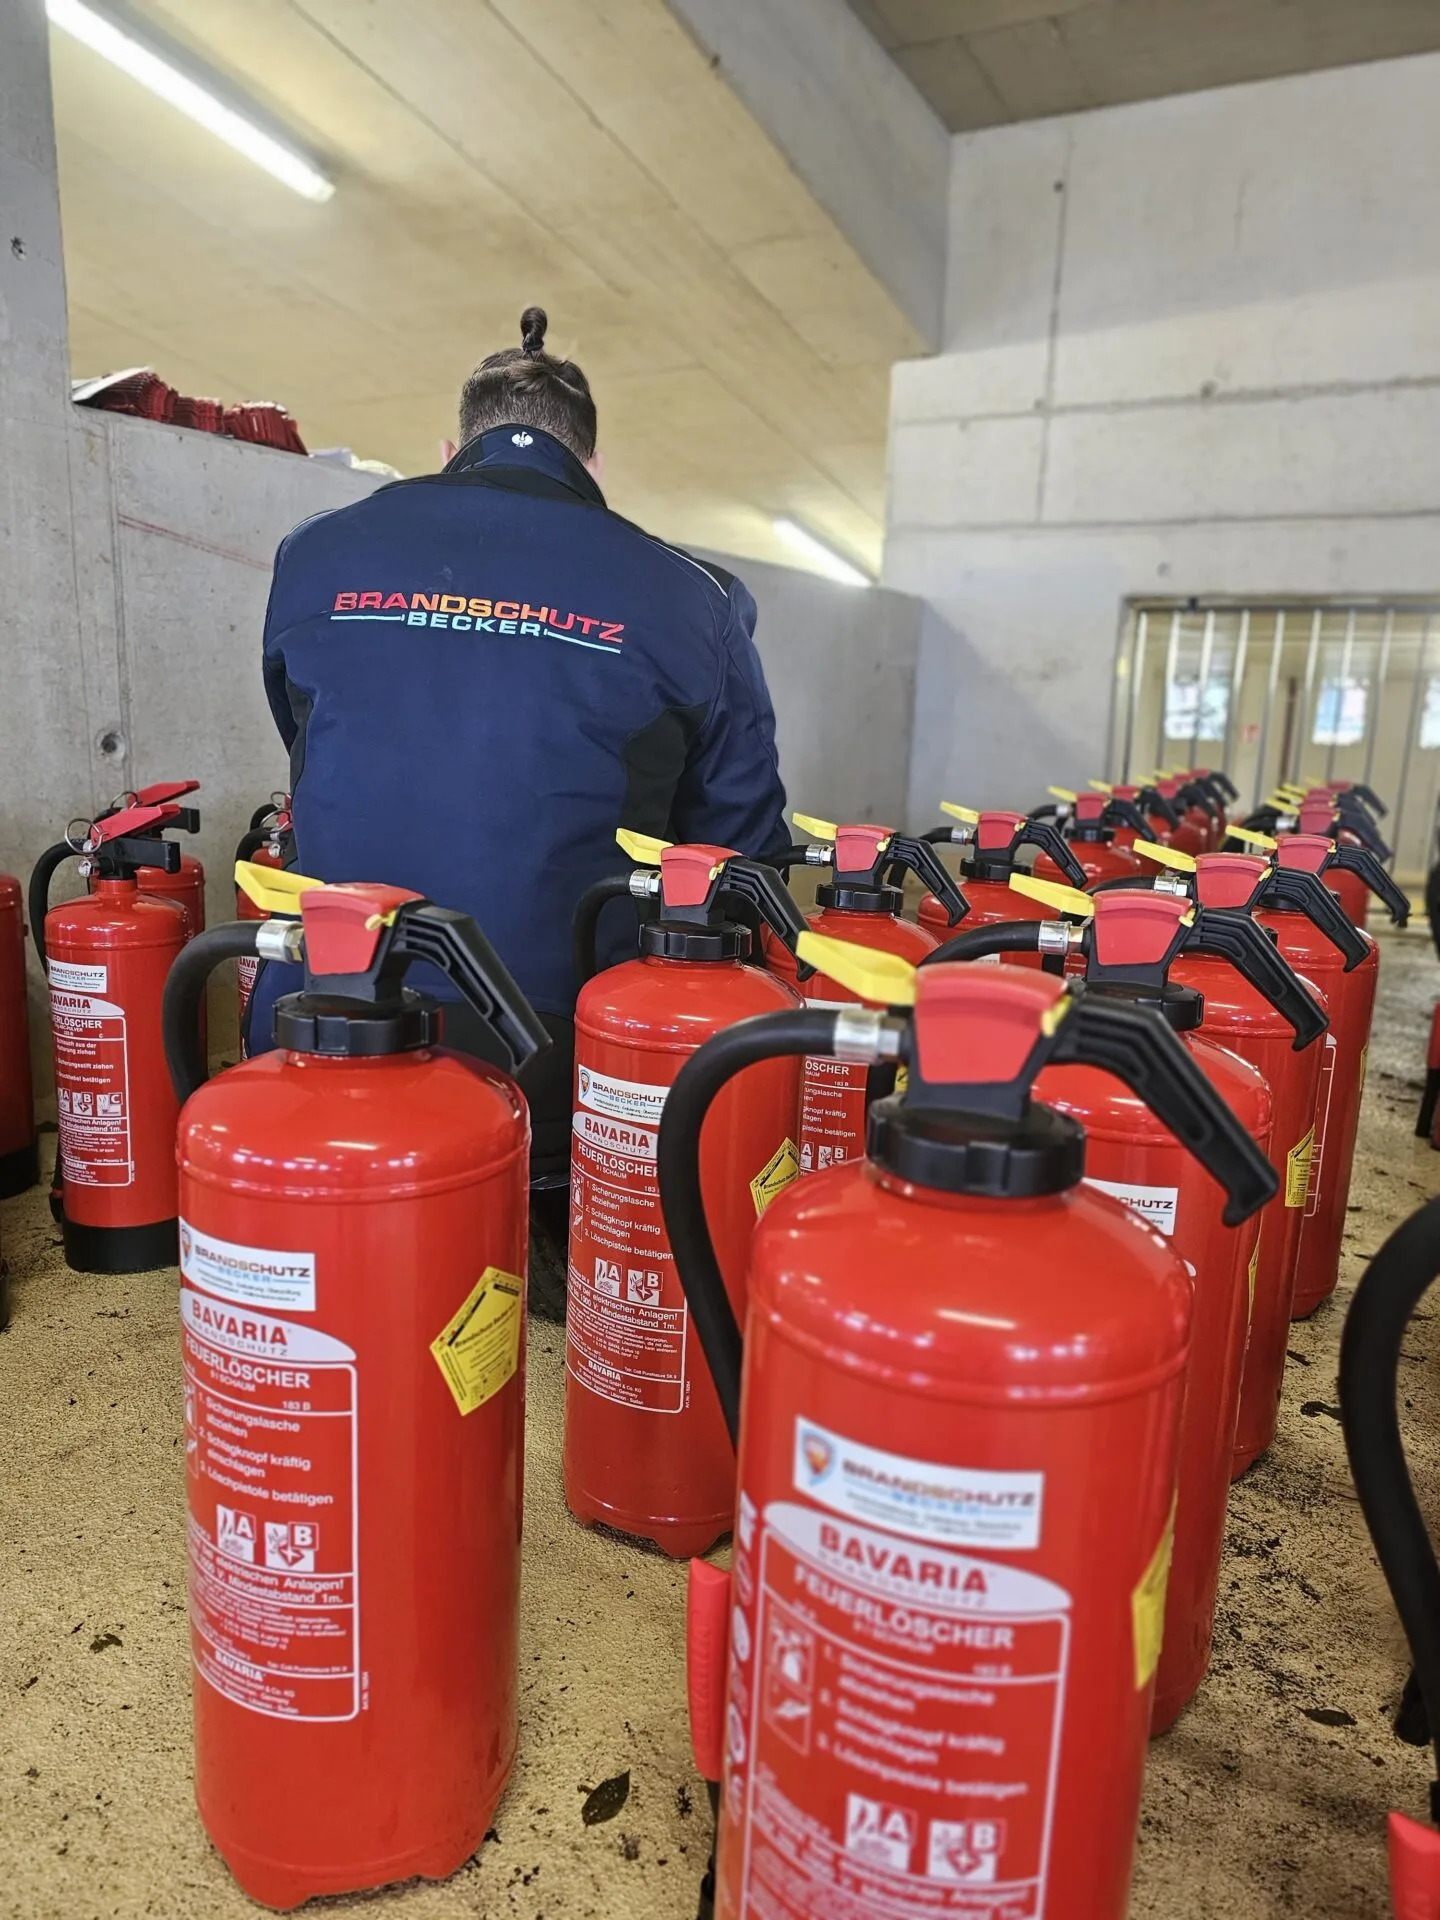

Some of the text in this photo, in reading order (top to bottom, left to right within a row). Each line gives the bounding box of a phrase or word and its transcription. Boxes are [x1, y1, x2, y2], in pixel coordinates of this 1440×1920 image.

[333, 592, 625, 643] BRANDSCHUTZ
[407, 611, 541, 637] BECKER
[50, 966, 105, 978] BRANDSCHUTZ
[63, 1091, 120, 1103] A B C
[592, 1081, 666, 1104] BRANDSCHUT
[609, 1095, 647, 1108] BECKER
[805, 1087, 842, 1098] ungslasche
[584, 1117, 650, 1148] BAVARIA
[584, 1131, 650, 1155] BRANDSCHUTZ
[802, 1125, 856, 1138] pistole betätigen
[802, 1143, 844, 1158] A B
[591, 1183, 655, 1208] Sicherungslasche
[590, 1219, 631, 1239] einschlagen
[591, 1208, 632, 1229] Schlagknopf
[634, 1222, 661, 1235] kräftig
[590, 1232, 632, 1253] Löschpistole
[633, 1247, 674, 1260] betätigen
[195, 1244, 311, 1278] BRANDSCHUTZ
[608, 1265, 659, 1287] A B
[192, 1298, 288, 1346] BAVARIA
[600, 1305, 659, 1328] Mindestabstand
[638, 1309, 678, 1321] Anlagen!
[185, 1333, 311, 1389] FEUERLÖSCHER
[588, 1360, 622, 1380] BAVARIA
[270, 1453, 311, 1471] kräftig
[271, 1489, 334, 1508] betätigen
[236, 1515, 313, 1546] A B
[819, 1523, 989, 1594] BAVARIA
[283, 1578, 344, 1593] Anlagen!
[795, 1563, 1015, 1650] FEUERLÖSCHER
[883, 1810, 996, 1850] A B
